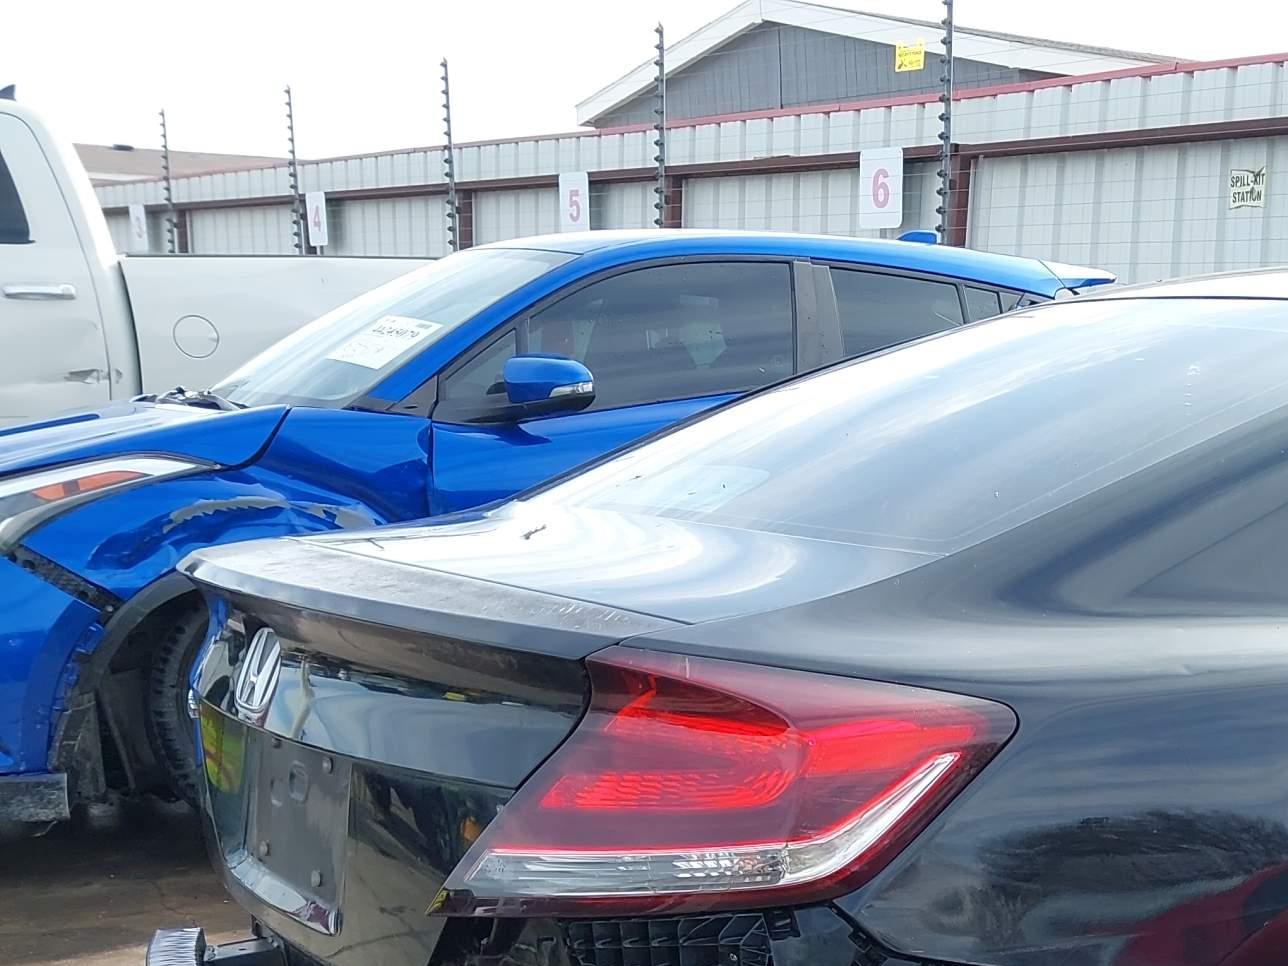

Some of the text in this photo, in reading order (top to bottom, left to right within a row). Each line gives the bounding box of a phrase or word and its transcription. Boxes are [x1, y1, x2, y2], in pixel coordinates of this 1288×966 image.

[872, 167, 890, 209] 6
[1232, 189, 1262, 204] STATION
[313, 205, 322, 232] 4
[568, 189, 581, 223] 5
